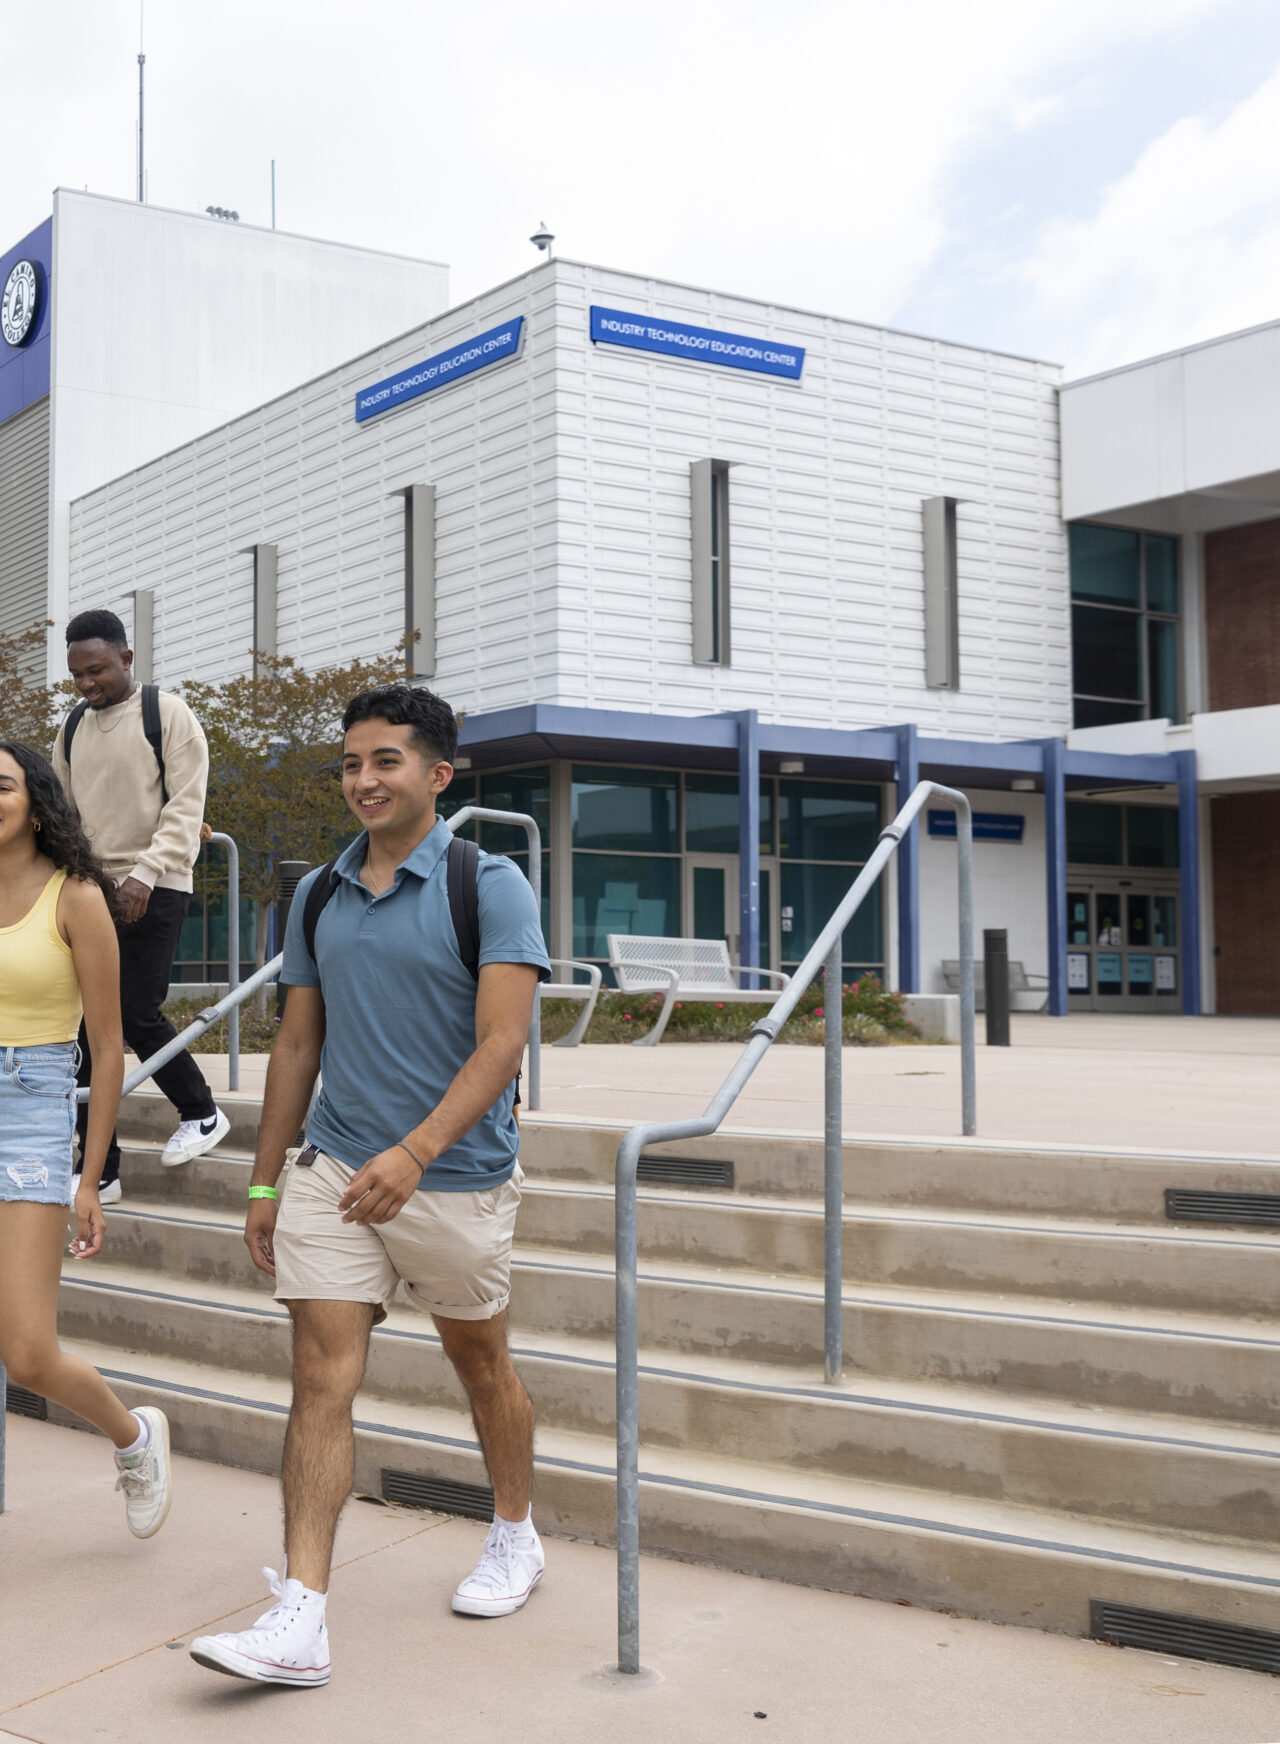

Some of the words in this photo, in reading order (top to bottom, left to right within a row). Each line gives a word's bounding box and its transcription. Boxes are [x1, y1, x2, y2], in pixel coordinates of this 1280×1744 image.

[3, 290, 10, 307] EL
[11, 263, 34, 287] CAMINO
[4, 305, 33, 342] COLLEGE
[600, 319, 645, 336] INDUSTRY
[646, 328, 711, 350] TECHNOLOGY
[711, 340, 763, 360] EDUCATION
[763, 351, 796, 367] CENTER
[360, 388, 391, 409] INDUSTRY
[391, 367, 439, 395] TECHNOLOGY
[439, 346, 482, 374] EDUCATION
[483, 332, 512, 354] CENTER
